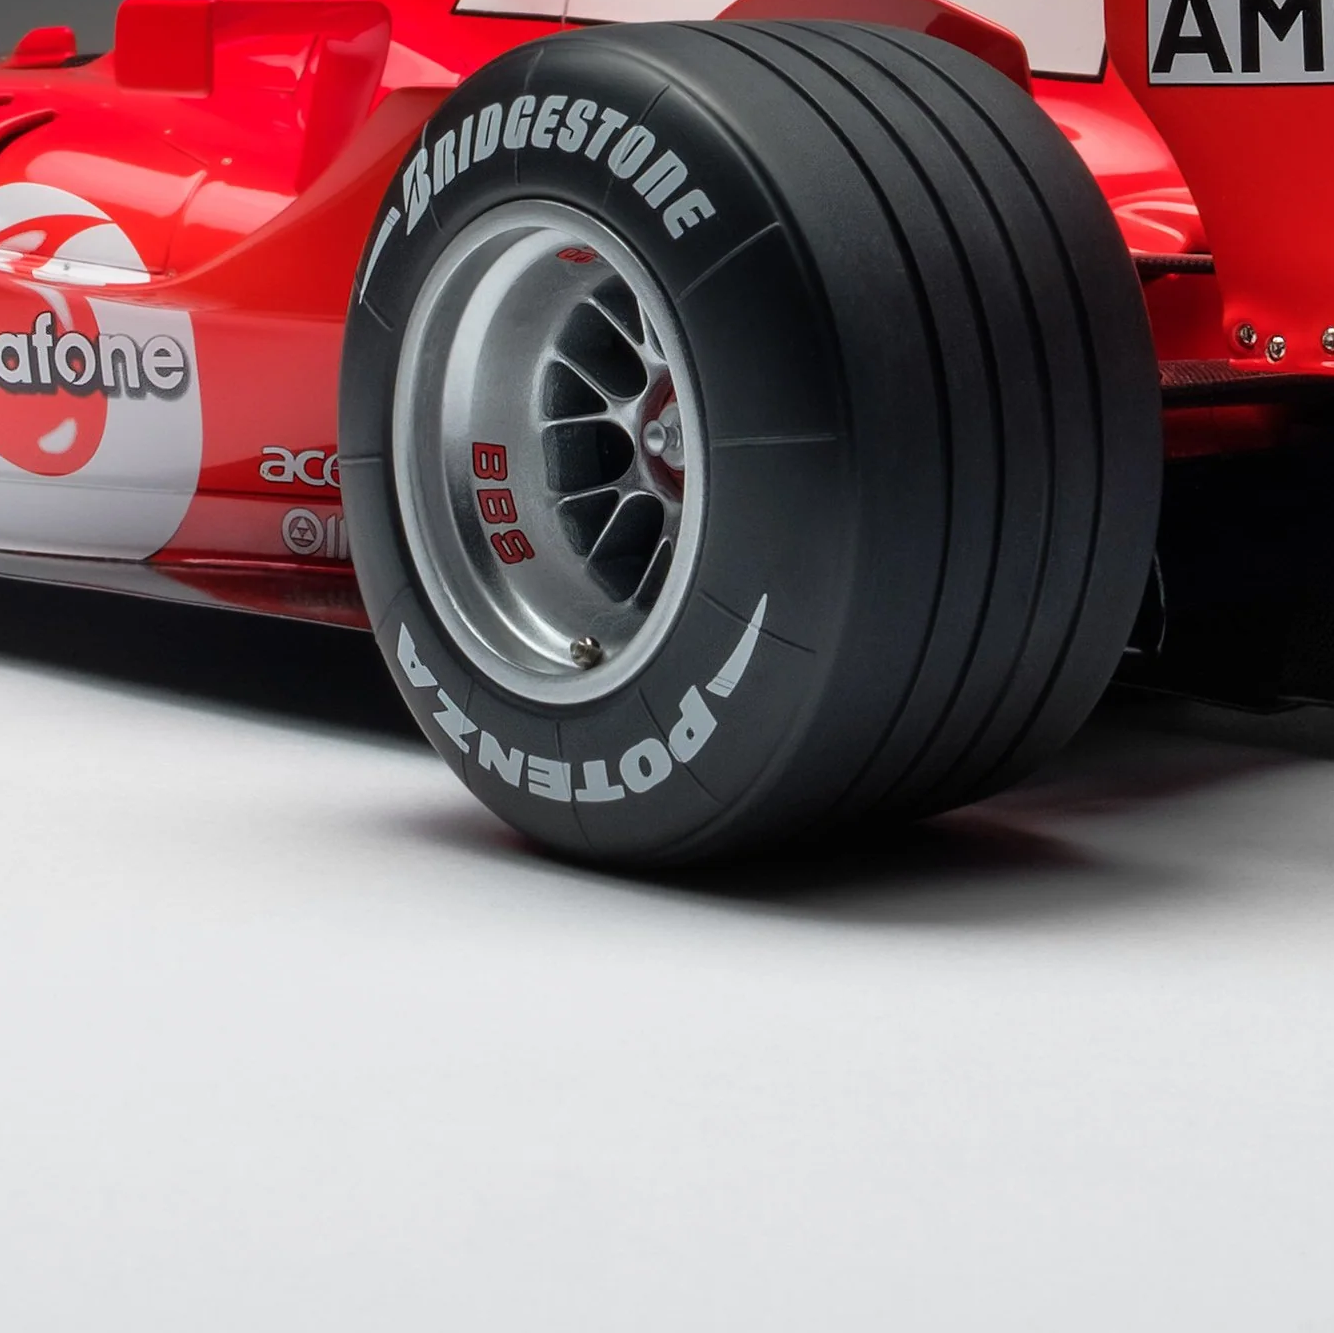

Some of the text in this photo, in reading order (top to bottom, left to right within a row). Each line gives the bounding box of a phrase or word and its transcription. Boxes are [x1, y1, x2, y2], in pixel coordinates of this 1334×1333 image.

[398, 94, 717, 239] BRIDGESTONE
[472, 441, 535, 565] BBS
[396, 620, 721, 804] POTENZA
